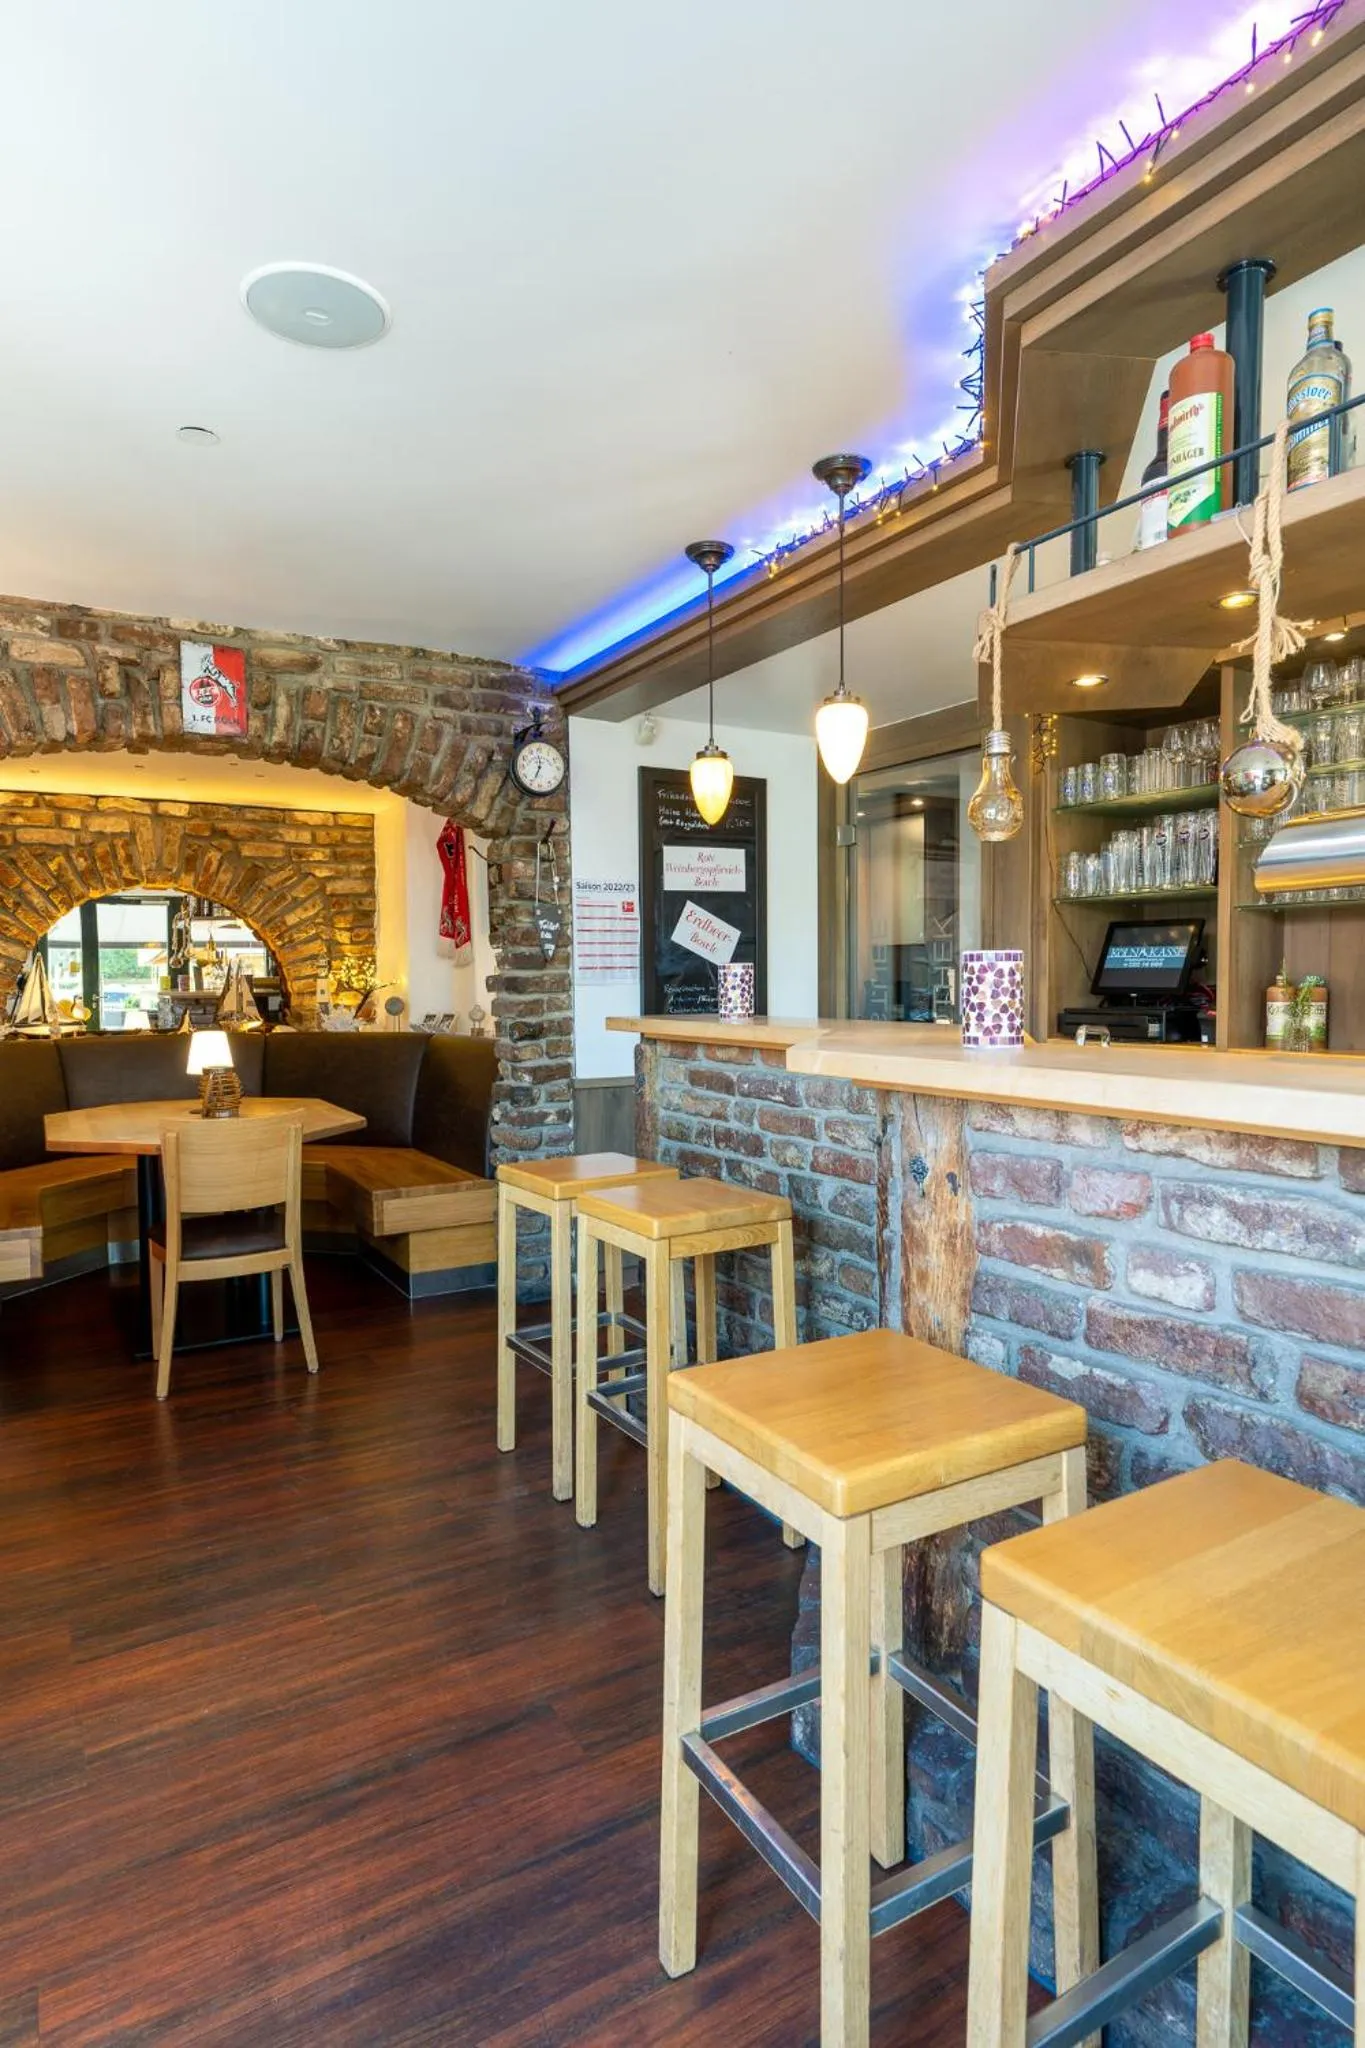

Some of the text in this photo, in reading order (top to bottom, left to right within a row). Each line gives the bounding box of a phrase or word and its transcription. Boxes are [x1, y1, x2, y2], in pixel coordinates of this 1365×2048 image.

[201, 715, 211, 723] FC
[576, 881, 636, 893] Saison 2022/23
